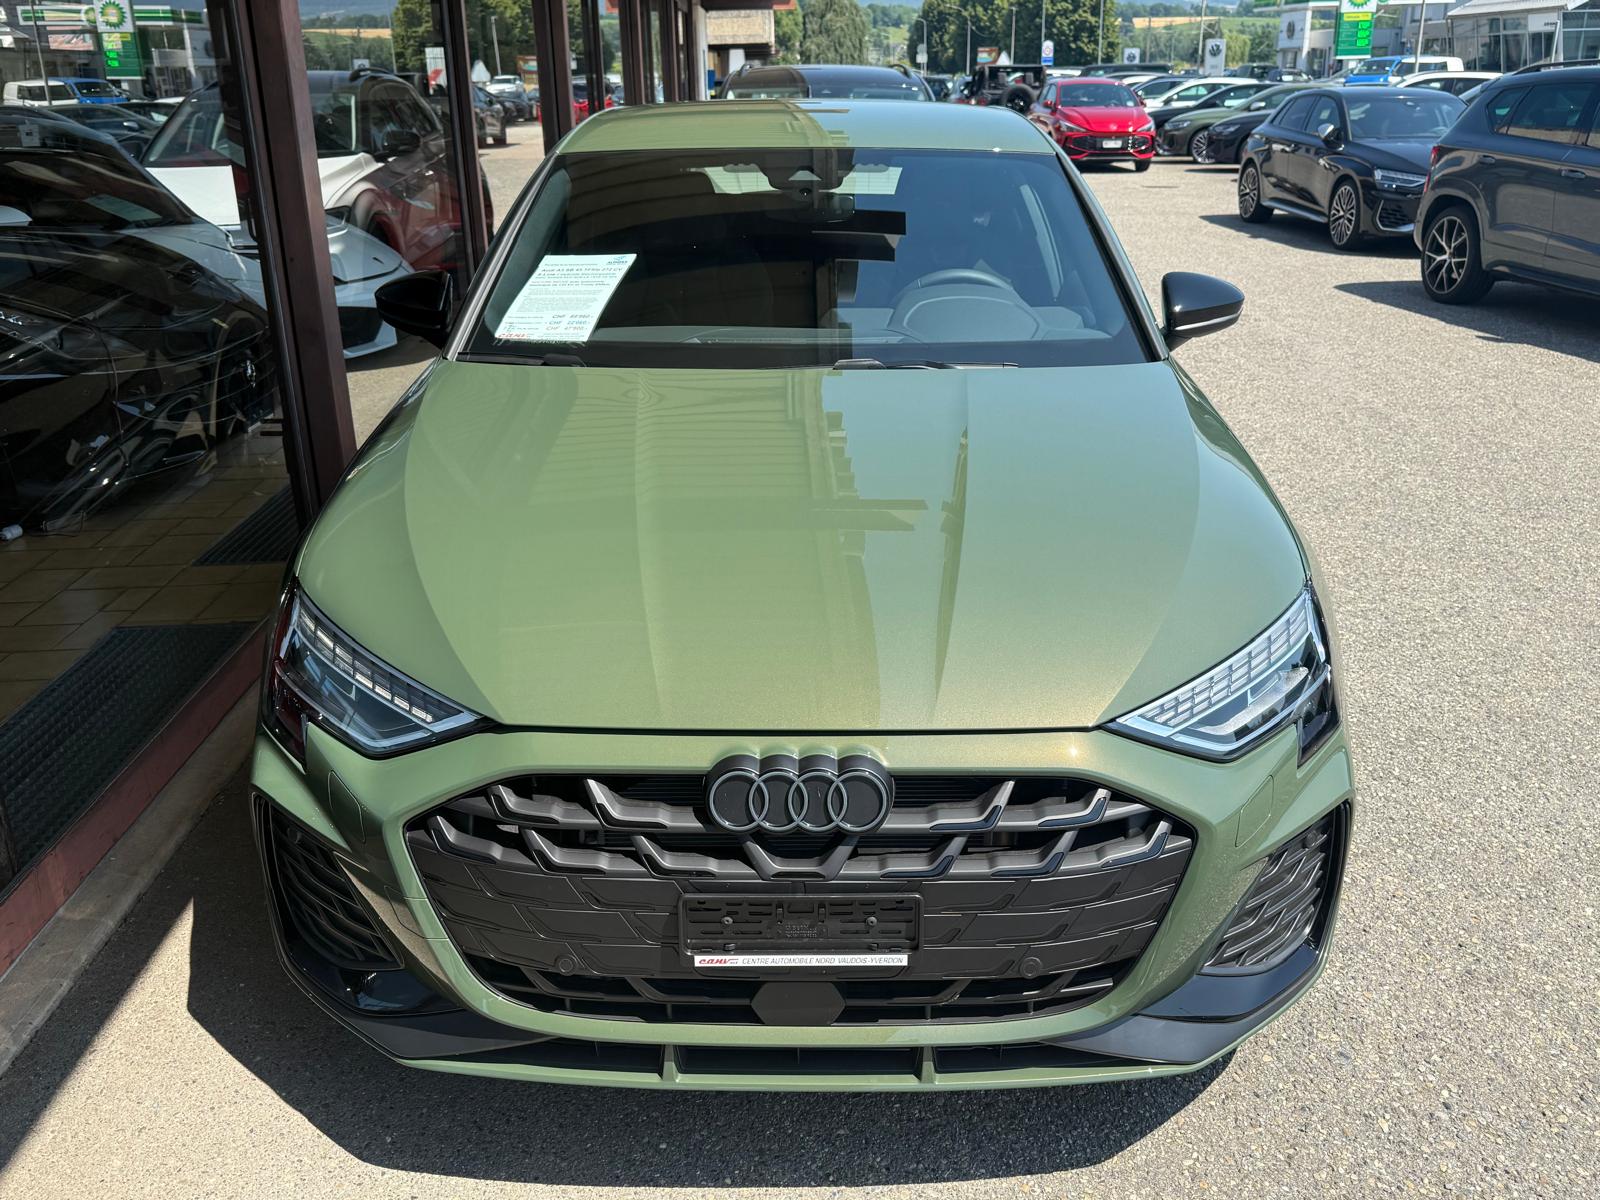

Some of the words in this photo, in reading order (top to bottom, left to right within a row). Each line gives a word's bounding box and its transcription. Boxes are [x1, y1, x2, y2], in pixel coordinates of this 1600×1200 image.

[741, 957, 769, 965] CENTRE
[769, 957, 814, 965] AUTOMOBILE
[815, 957, 836, 965] NORD
